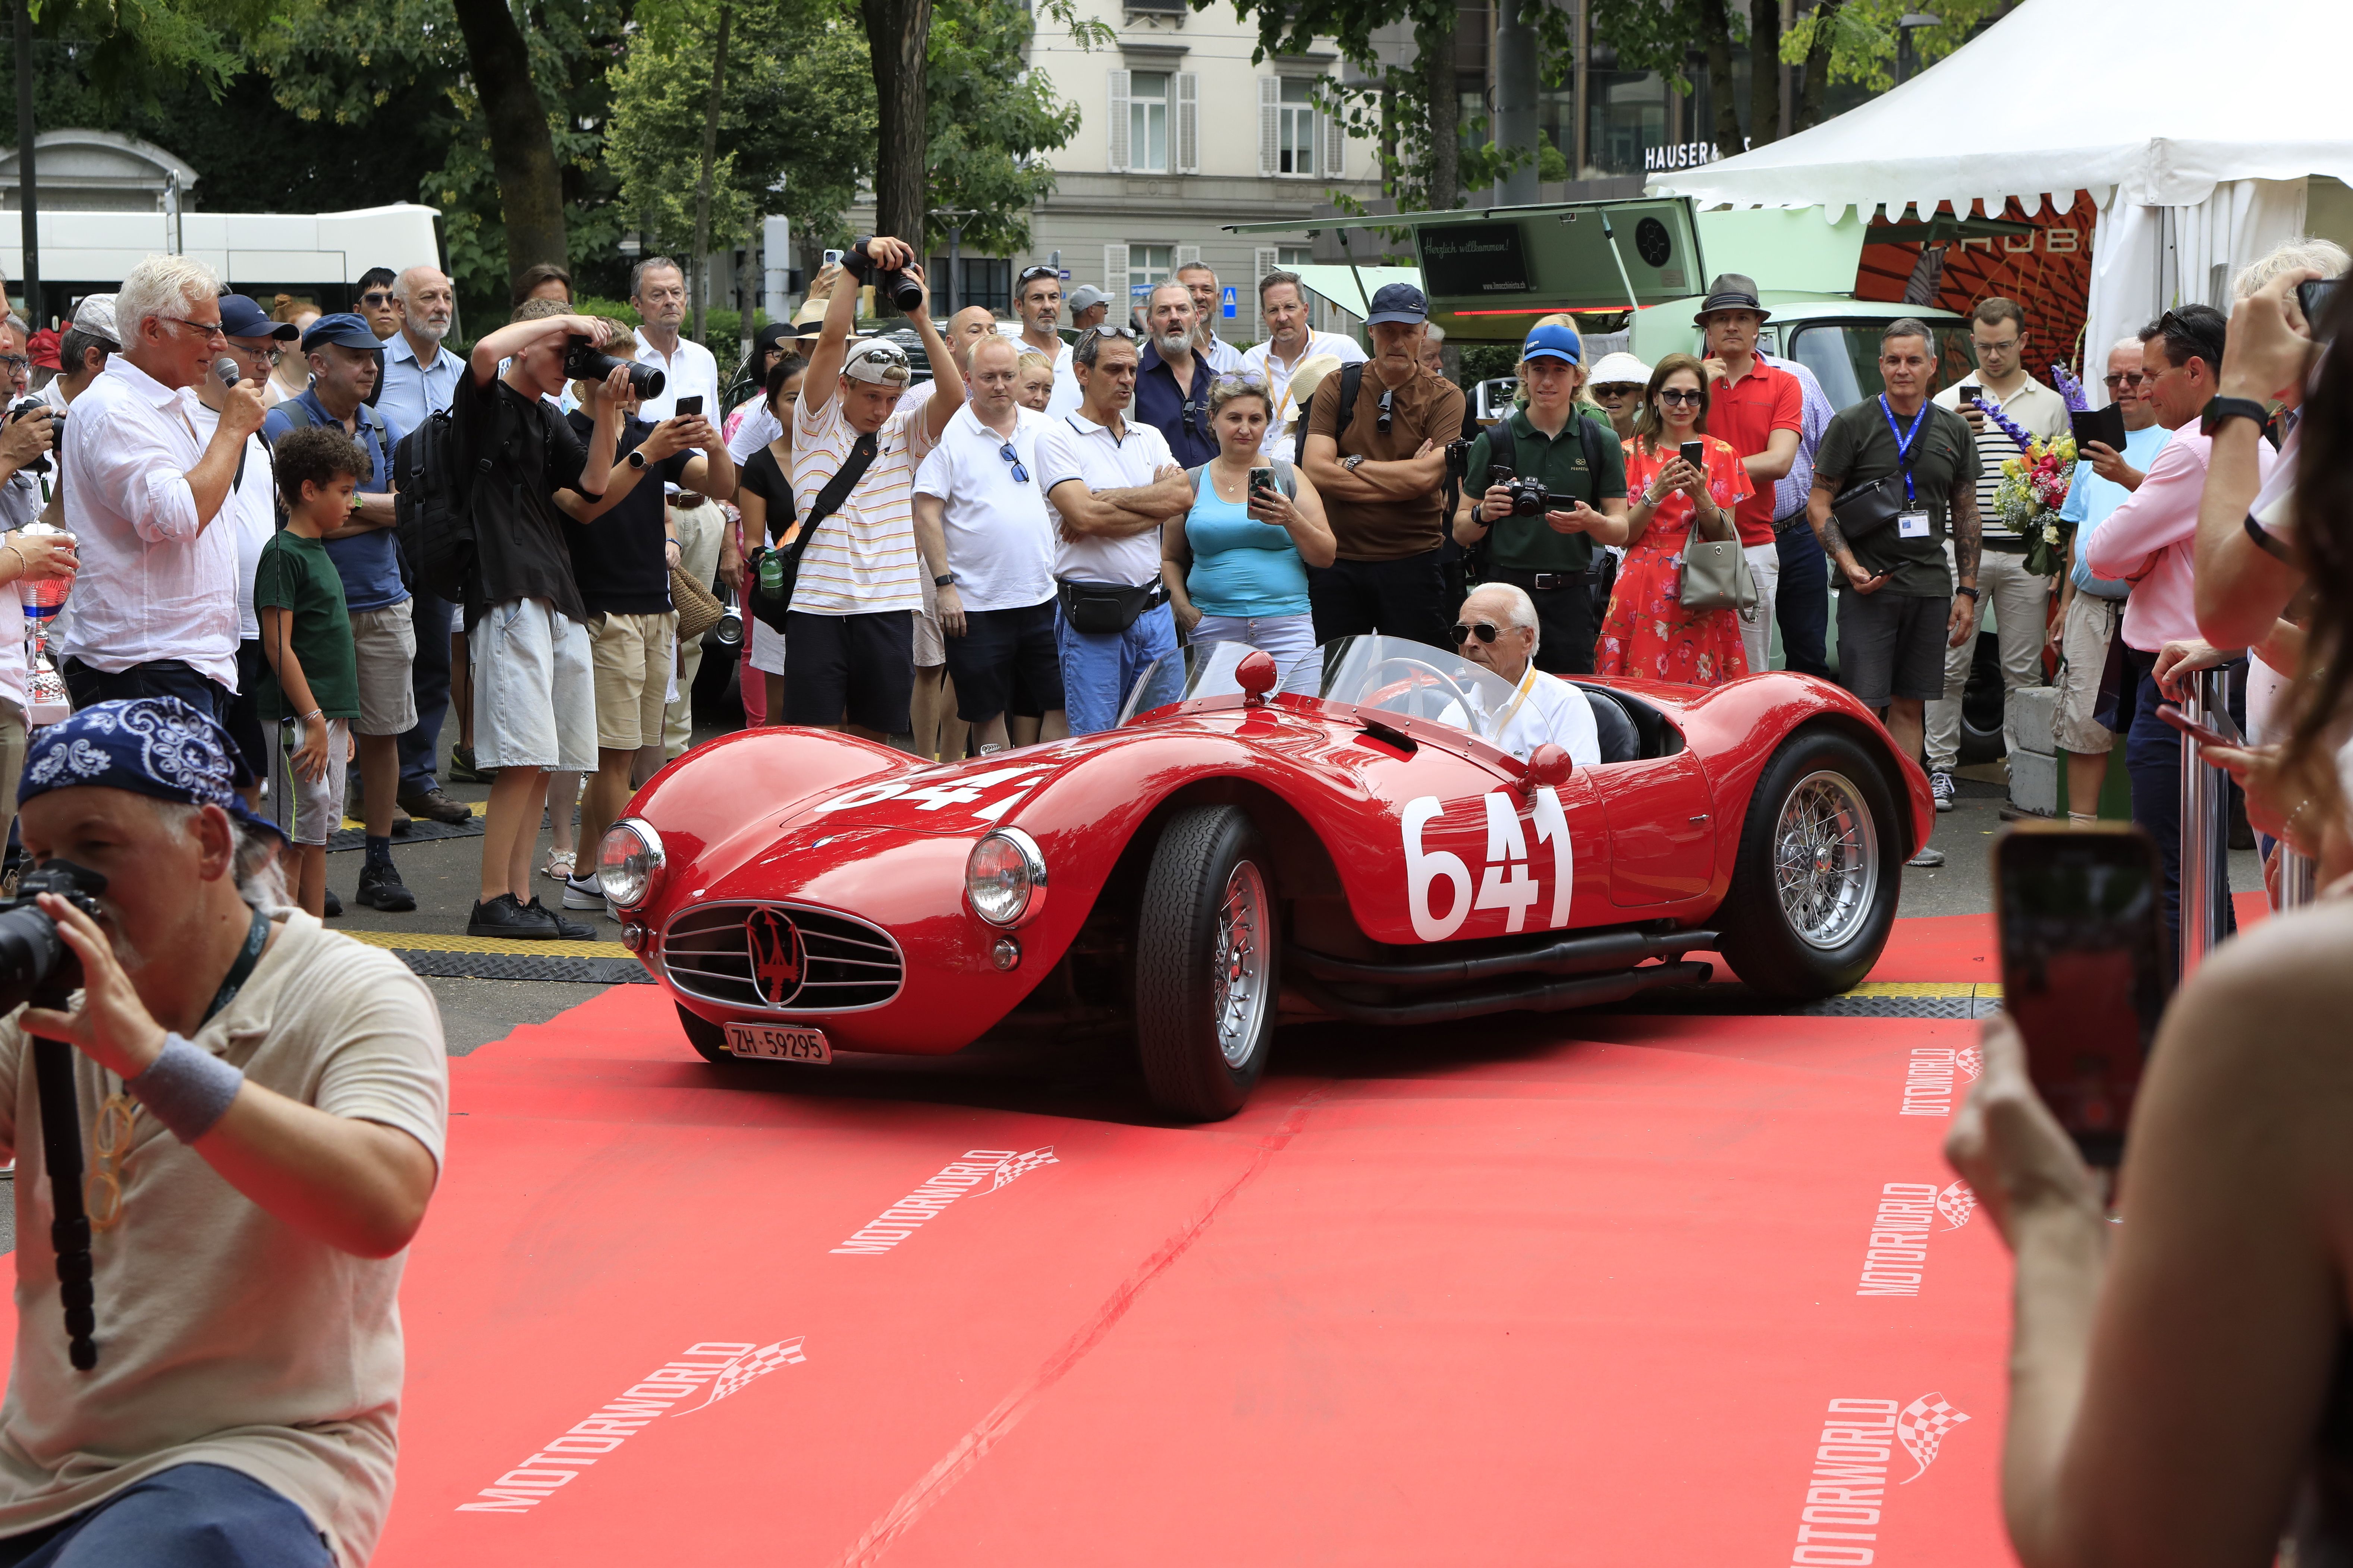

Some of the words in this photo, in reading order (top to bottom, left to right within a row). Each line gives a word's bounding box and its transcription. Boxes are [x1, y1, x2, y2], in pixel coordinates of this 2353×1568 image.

[1645, 141, 1709, 170] HAUSER
[1424, 237, 1457, 259] Herzlich
[1460, 239, 1509, 253] willkommen!
[1920, 229, 2095, 253] HUB
[1882, 400, 1893, 419] CHUBB
[1914, 407, 1924, 426] CHUBB
[1902, 434, 1912, 451] CHUBB
[1401, 787, 1574, 942] 641
[828, 1149, 1018, 1254] MOTORWORLD
[1856, 1182, 1938, 1297] MOTORWORLD
[454, 1341, 757, 1514] MOTORWORLD
[1790, 1398, 1899, 1568] OTORWORLD
